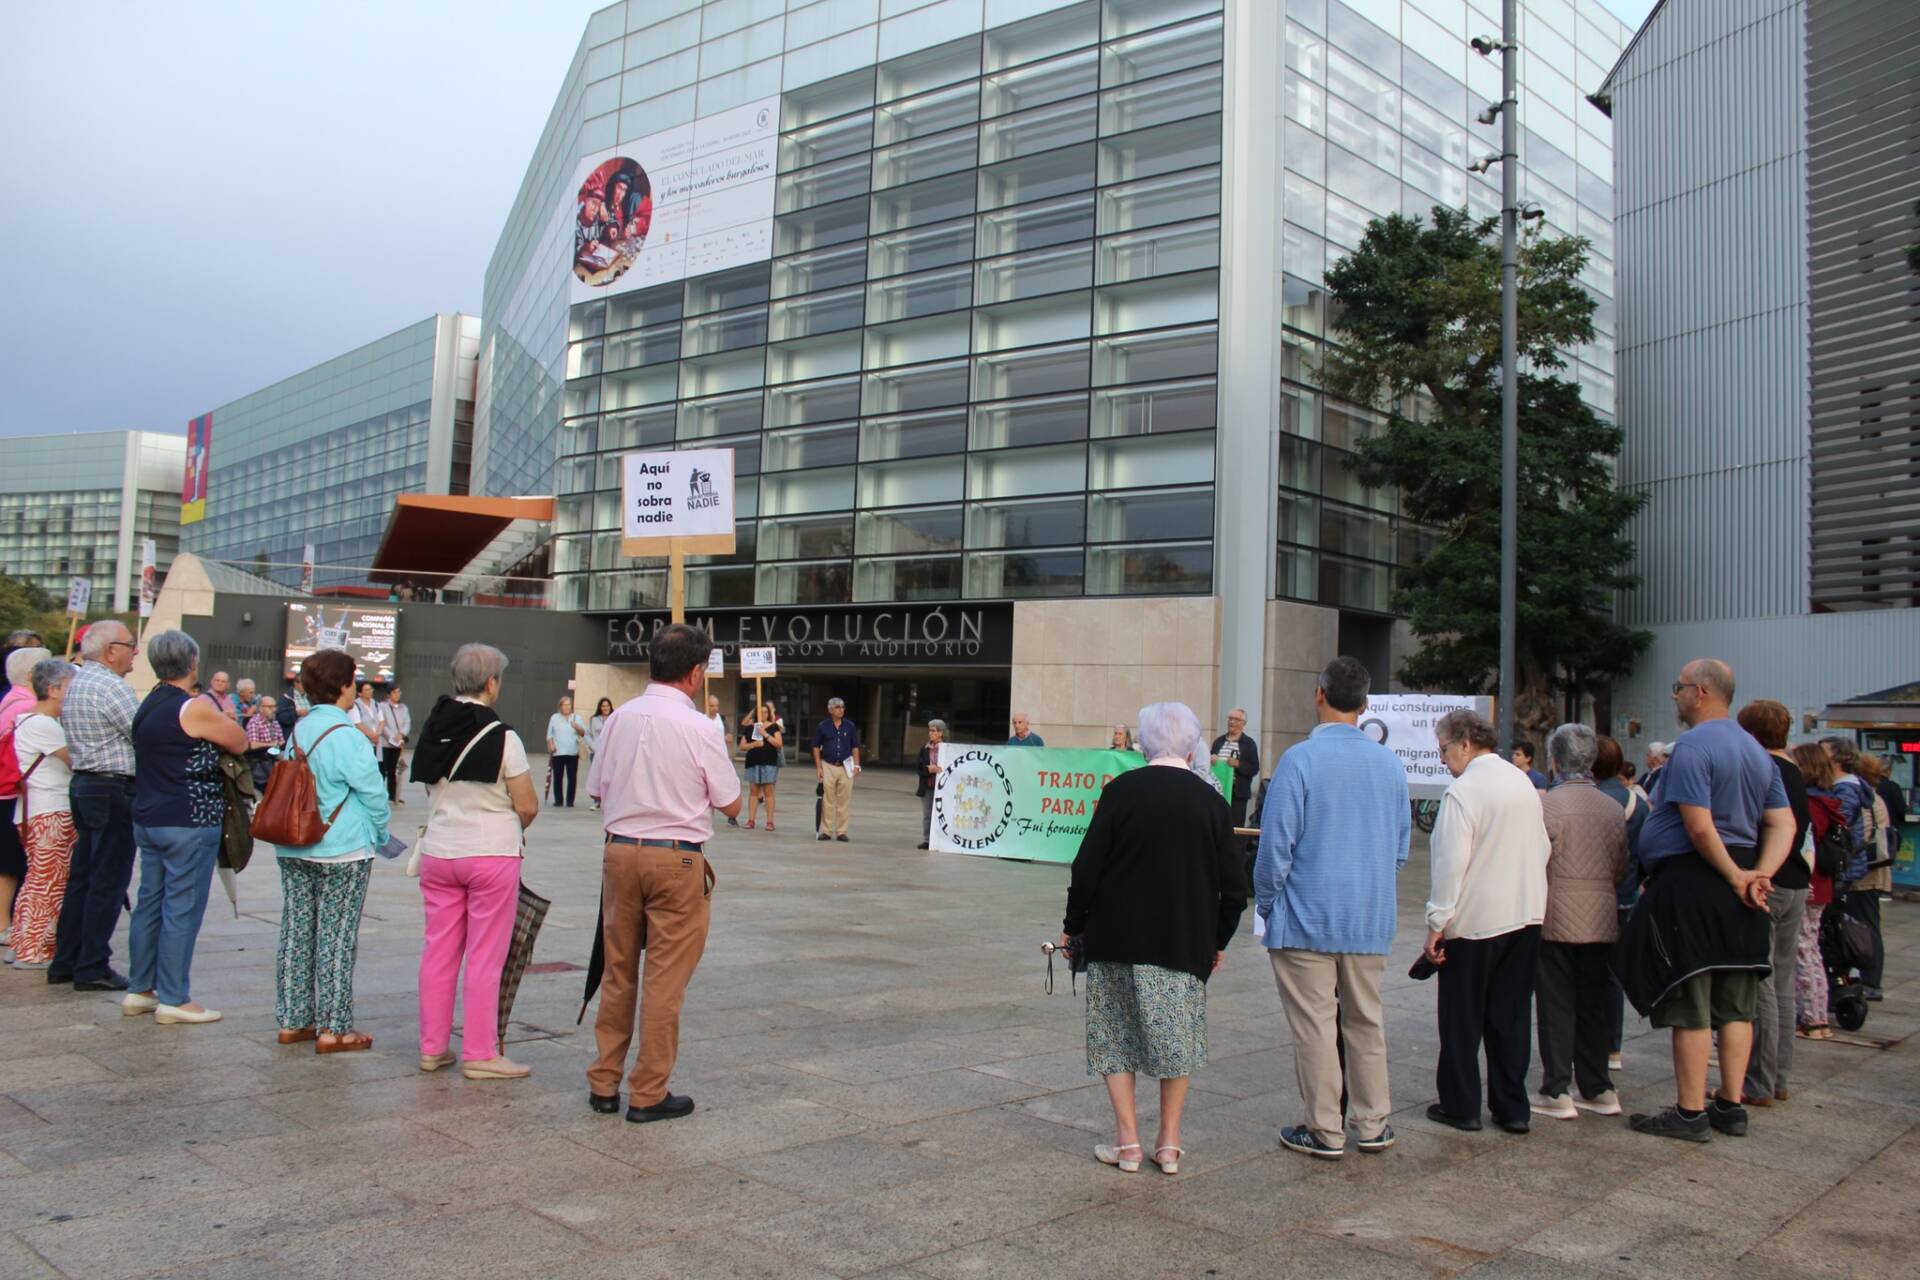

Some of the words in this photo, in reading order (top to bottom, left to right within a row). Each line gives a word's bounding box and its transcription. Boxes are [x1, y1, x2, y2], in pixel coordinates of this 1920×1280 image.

[640, 461, 670, 476] Aquí
[647, 481, 662, 490] no
[638, 495, 672, 507] sobra
[687, 496, 720, 511] NADIE
[637, 511, 673, 523] nadie
[608, 613, 714, 642] FÓRM
[739, 606, 983, 643] EVOLUCIÓN
[837, 642, 846, 656] Y
[859, 641, 980, 656] AUDITORIO
[1412, 719, 1427, 728] un
[1038, 771, 1095, 790] TRATO
[1041, 797, 1085, 816] PARA
[935, 797, 948, 836] DEL
[952, 800, 1013, 850] SILENCIO
